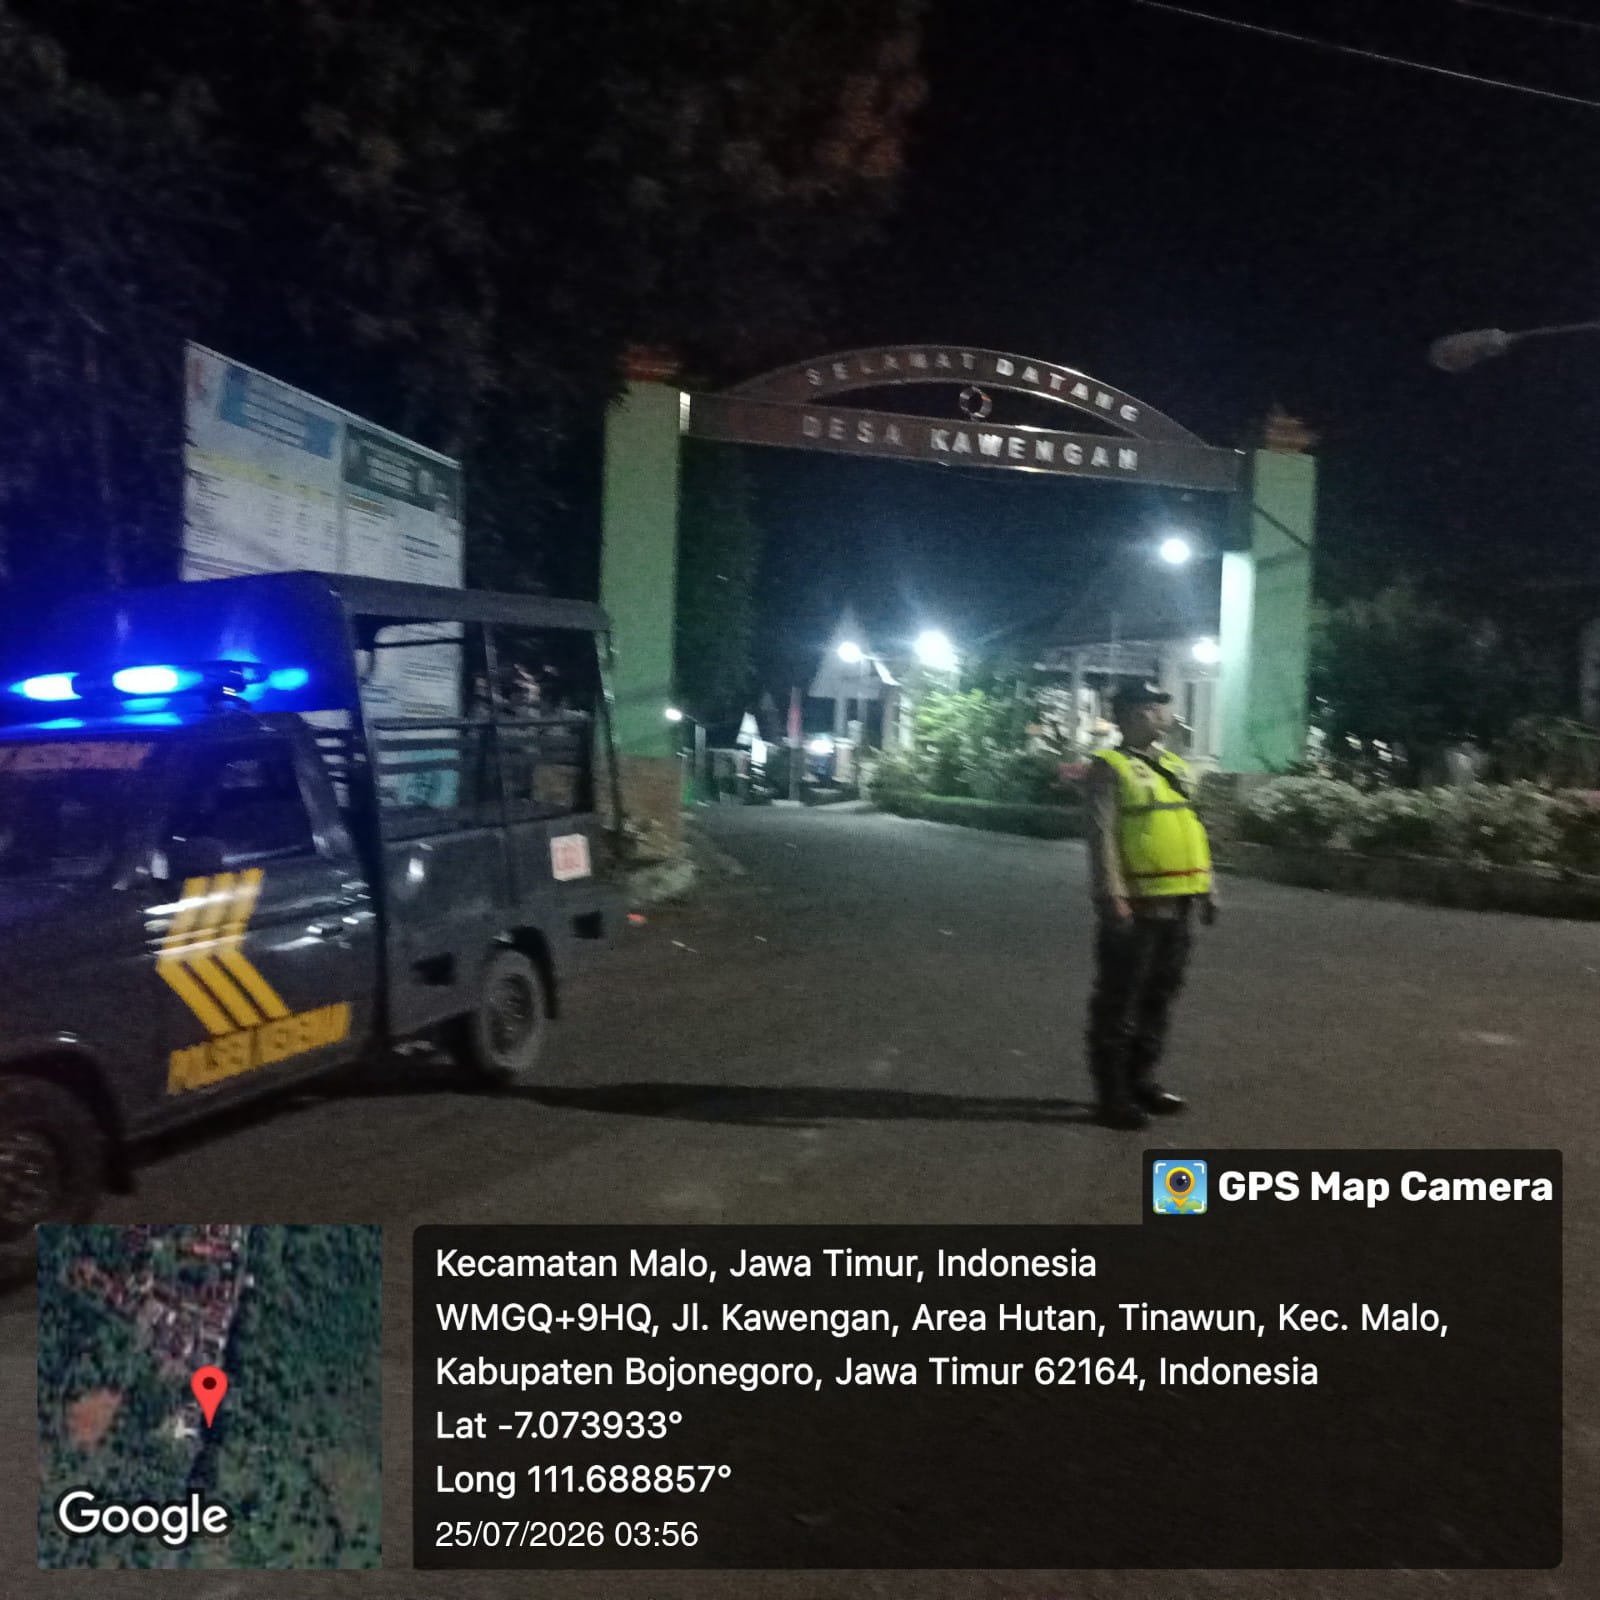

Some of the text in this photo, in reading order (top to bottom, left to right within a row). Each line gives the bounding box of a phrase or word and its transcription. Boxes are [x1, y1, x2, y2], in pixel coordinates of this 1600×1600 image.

[806, 352, 1140, 423] SELAMAT DATANG
[801, 415, 1138, 472] DESA KAWENGAN
